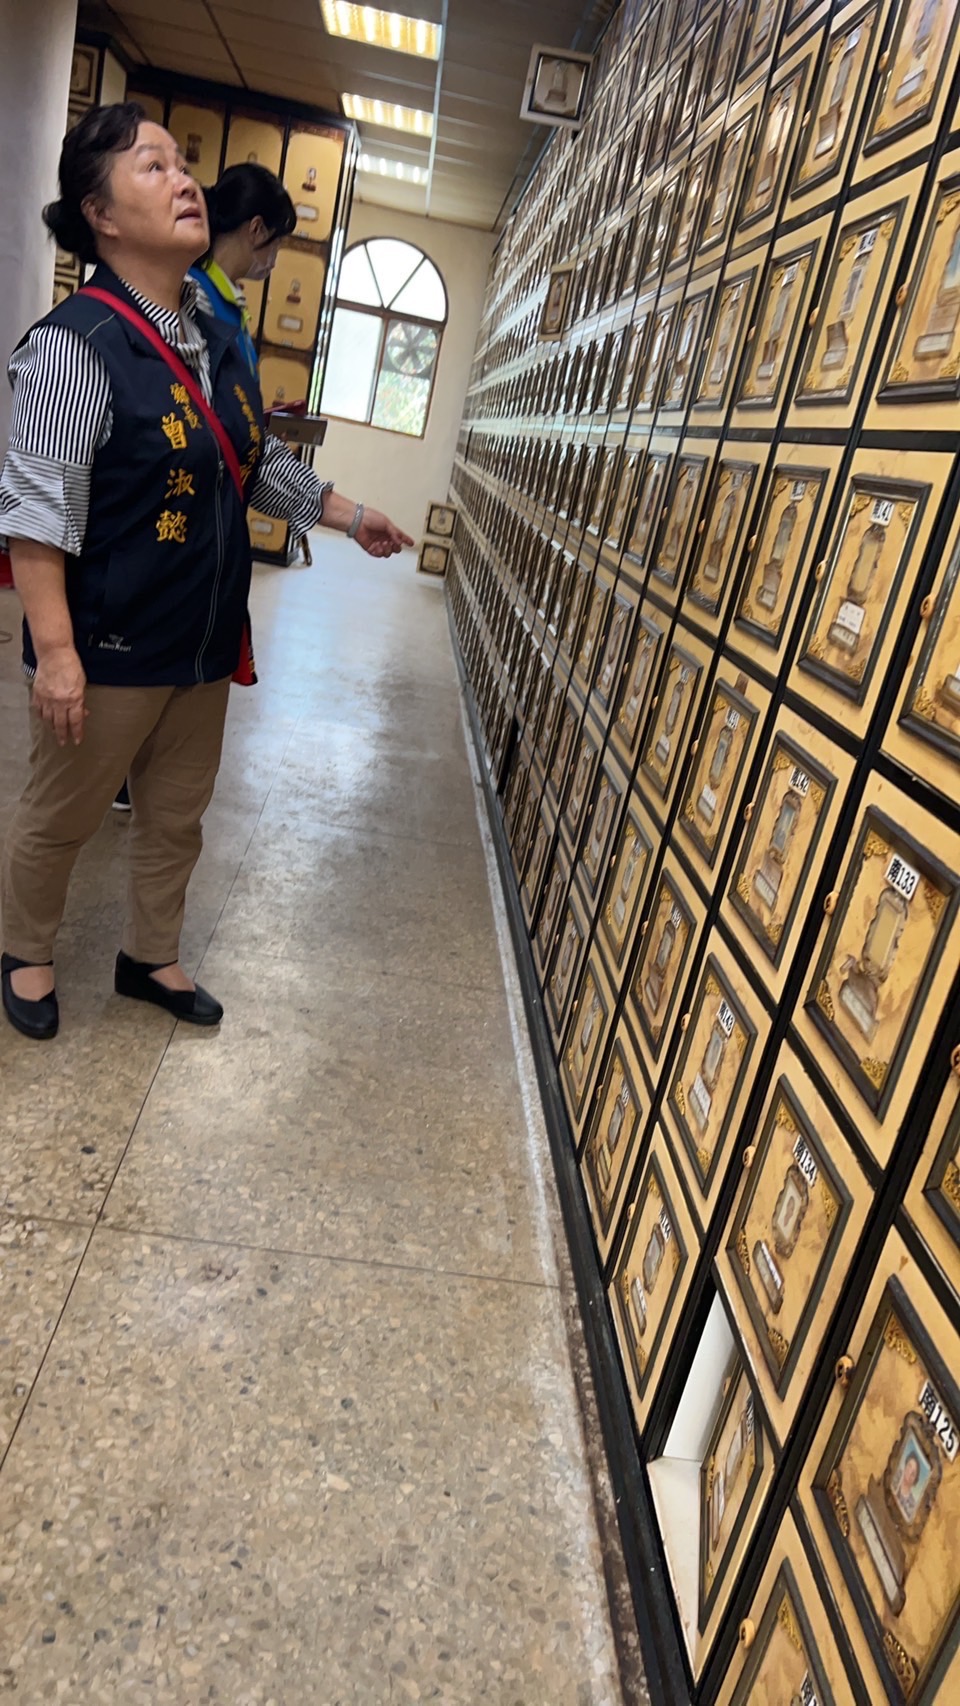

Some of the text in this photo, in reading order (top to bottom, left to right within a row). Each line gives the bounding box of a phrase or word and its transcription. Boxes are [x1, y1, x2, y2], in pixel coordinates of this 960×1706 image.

[887, 857, 916, 895] 南133
[794, 1135, 817, 1182] 南134
[918, 1381, 957, 1454] 南125
